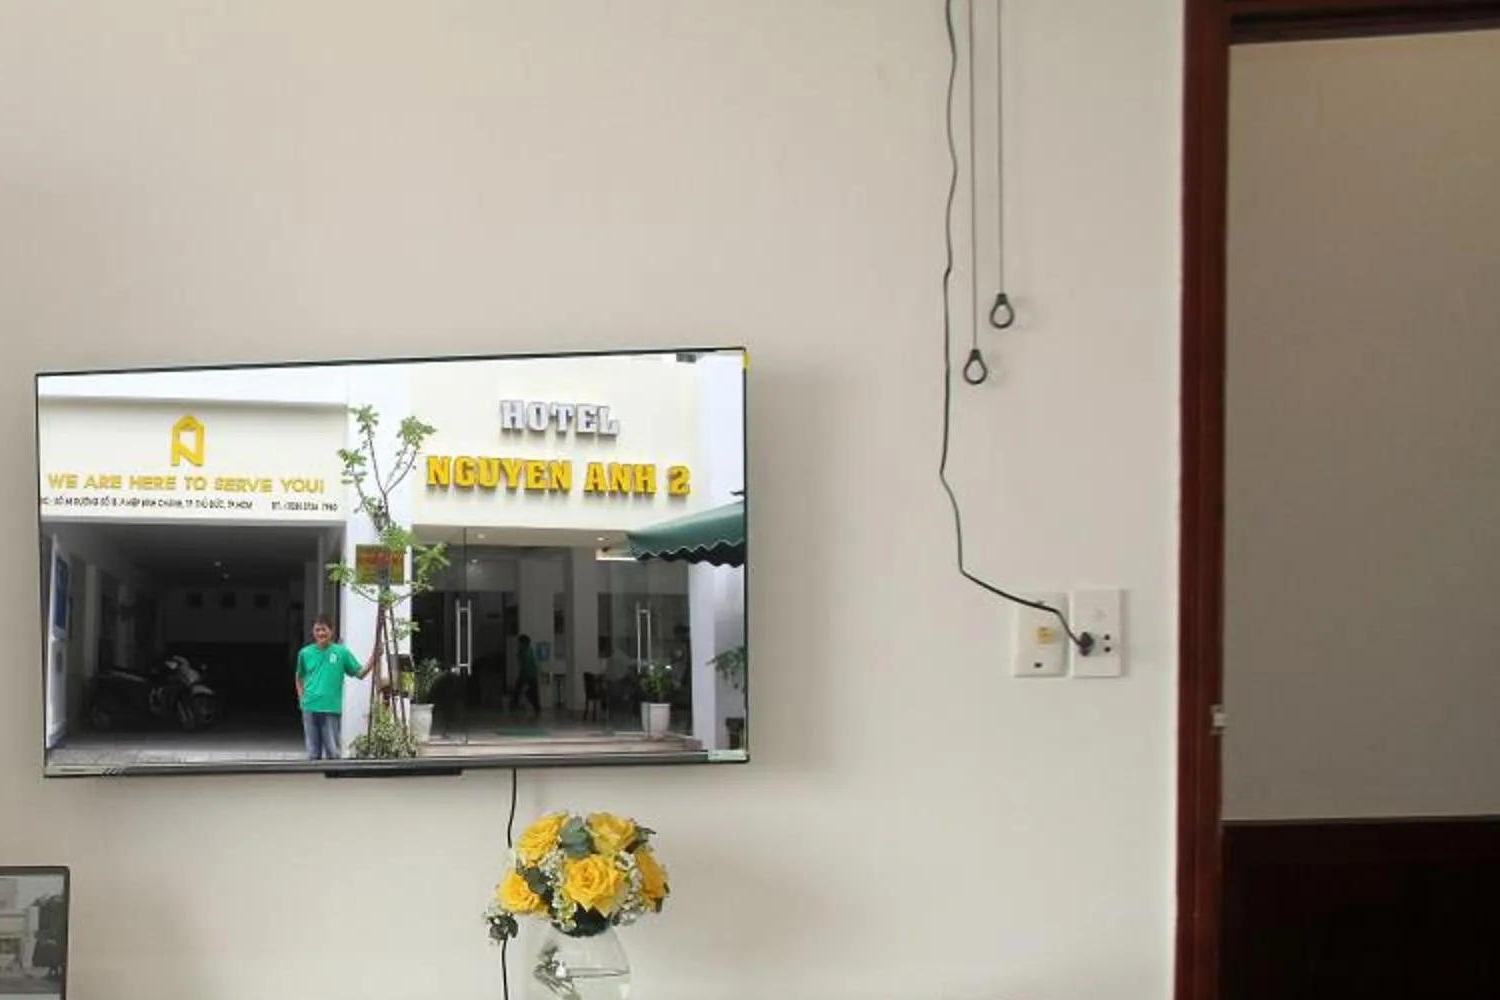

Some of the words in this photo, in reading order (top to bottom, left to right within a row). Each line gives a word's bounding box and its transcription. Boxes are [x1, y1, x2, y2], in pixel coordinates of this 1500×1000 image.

[501, 400, 620, 436] HOTEL
[47, 473, 78, 490] WE
[83, 474, 122, 490] ARE
[129, 475, 177, 491] HERE
[185, 476, 206, 491] TO
[215, 477, 273, 493] SERVE
[426, 455, 572, 491] NGUYEN
[583, 461, 657, 494] ANH
[667, 465, 691, 496] 2
